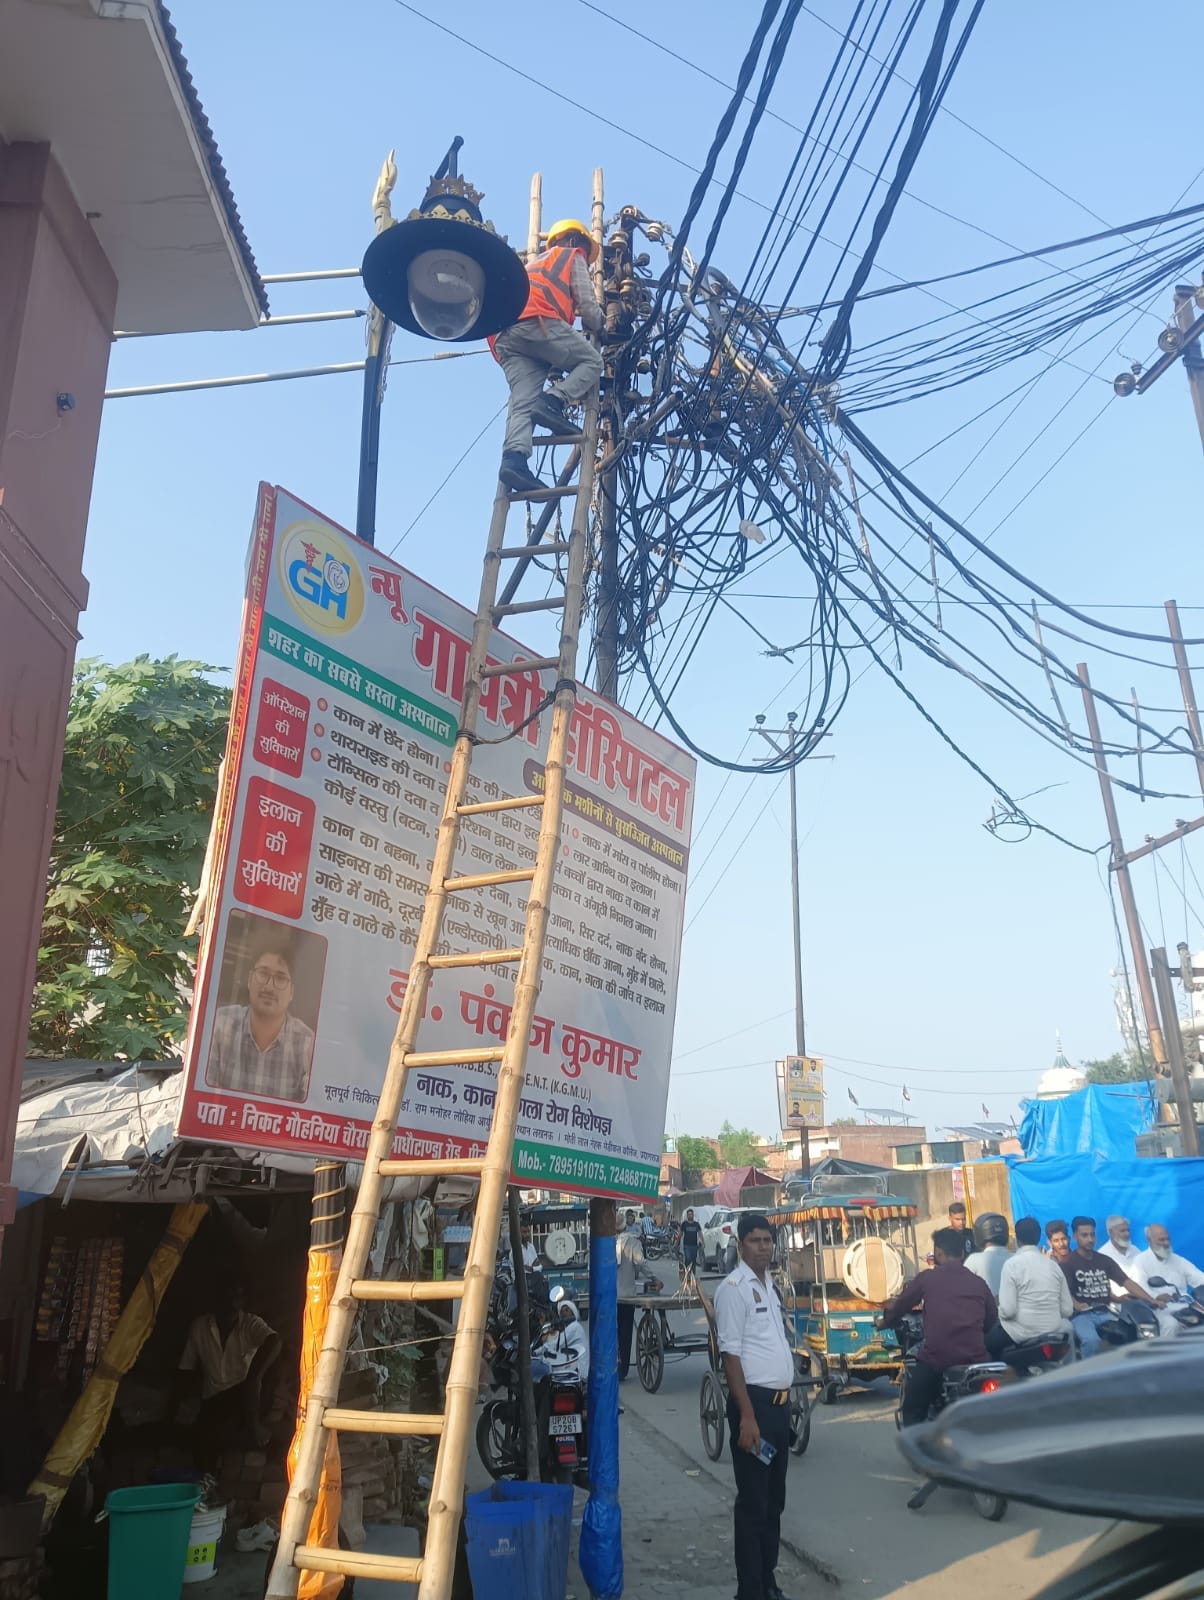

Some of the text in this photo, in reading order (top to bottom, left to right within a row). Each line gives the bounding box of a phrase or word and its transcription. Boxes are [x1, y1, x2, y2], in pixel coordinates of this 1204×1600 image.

[368, 565, 408, 624] न्यू
[268, 627, 450, 738] शहर का सबसे सस्ता अस्पताल
[263, 691, 306, 720] ऑपरेशन
[274, 718, 290, 735] की
[259, 735, 300, 761] सुविधायें
[333, 705, 365, 731] कान
[367, 720, 382, 739] में
[406, 740, 439, 768] होना।
[330, 730, 388, 767] थायराइड
[390, 758, 410, 778] की
[412, 769, 435, 790] दवा
[501, 812, 521, 832] द्वारा
[483, 781, 499, 799] की
[258, 795, 301, 826] इलाज
[574, 794, 604, 821] मशीनों
[605, 808, 613, 827] से
[650, 837, 683, 865] अस्पताल
[265, 831, 287, 855] की
[323, 778, 357, 803] कोई
[358, 793, 388, 822] वस्तु
[470, 843, 492, 864] डाल
[573, 891, 581, 905] व
[381, 778, 401, 798] की
[403, 789, 426, 810] दवा
[429, 800, 439, 816] व
[493, 831, 514, 851] द्वारा
[586, 876, 603, 894] द्वारा
[605, 886, 623, 902] नाक
[624, 895, 631, 908] व
[633, 899, 650, 917] कान
[651, 906, 660, 921] में
[582, 832, 601, 850] नाक
[602, 840, 612, 856] में
[612, 848, 629, 866] मांस
[630, 858, 636, 870] व
[242, 859, 302, 894] सुविधायें
[322, 815, 354, 840] कान
[359, 830, 379, 850] का
[578, 920, 595, 941] सिर
[615, 940, 633, 957] नाक
[572, 849, 590, 866] लार
[616, 871, 628, 886] का
[318, 842, 370, 874] साइनस
[373, 863, 393, 883] की
[472, 900, 484, 919] से
[486, 908, 508, 931] खून
[639, 970, 648, 986] में
[337, 908, 350, 924] व
[352, 912, 379, 934] गले
[380, 921, 396, 939] के
[314, 870, 344, 892] गले
[346, 878, 361, 899] में
[584, 972, 603, 990] गला
[604, 978, 617, 995] की
[635, 993, 642, 1005] व
[643, 996, 665, 1014] इलाज
[561, 1023, 642, 1080] कुमार
[197, 1101, 227, 1125] पता
[240, 1102, 283, 1133] निकट
[285, 1111, 339, 1143] गौहनिया
[414, 1103, 427, 1114] राम
[429, 1105, 451, 1120] मनोहर
[416, 1073, 457, 1103] नाक,
[545, 1098, 569, 1125] रोग
[571, 1104, 612, 1135] विशेषज्ञ
[549, 1154, 606, 1182] 7895191075,
[609, 1165, 658, 1190] 7248687777
